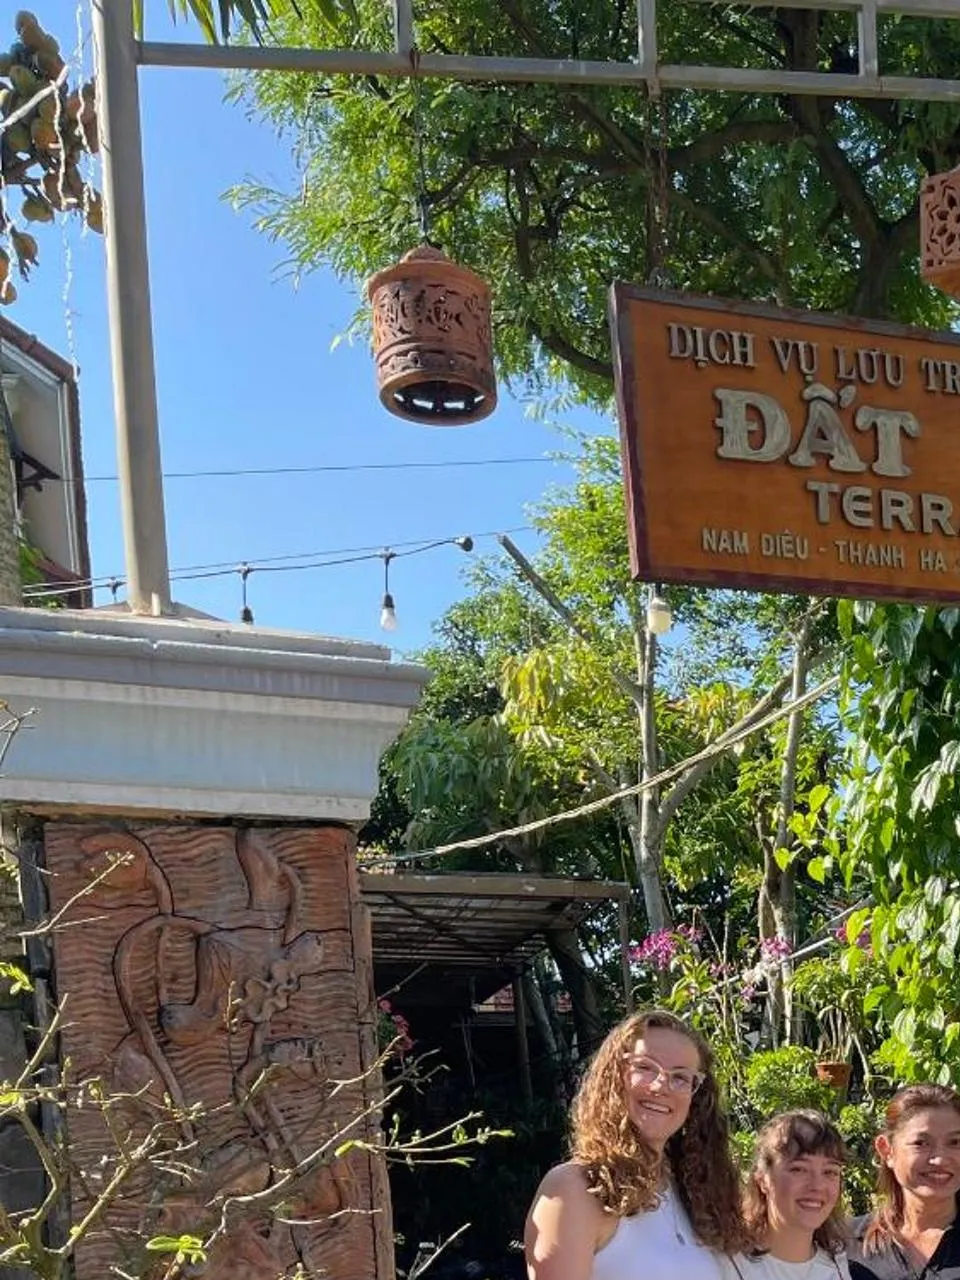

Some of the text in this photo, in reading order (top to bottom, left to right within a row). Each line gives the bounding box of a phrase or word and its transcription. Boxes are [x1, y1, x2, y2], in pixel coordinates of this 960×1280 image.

[667, 322, 755, 368] DỊCH
[770, 337, 819, 384] VỤ
[713, 382, 921, 478] ĐẤT
[702, 527, 749, 555] NAM
[761, 528, 809, 560] DIÊU
[834, 540, 905, 568] THANH
[920, 549, 948, 572] HA
